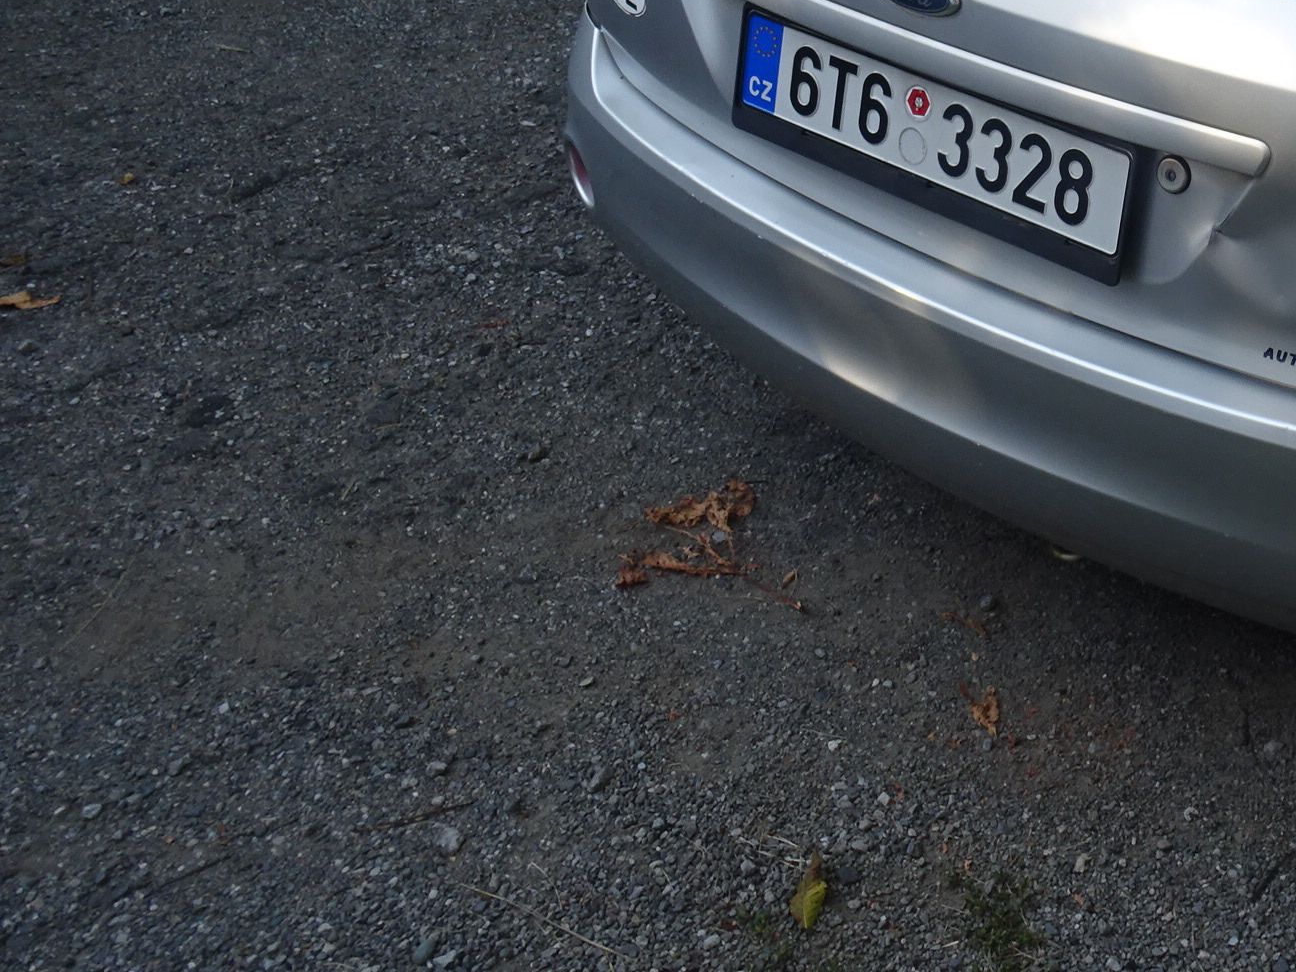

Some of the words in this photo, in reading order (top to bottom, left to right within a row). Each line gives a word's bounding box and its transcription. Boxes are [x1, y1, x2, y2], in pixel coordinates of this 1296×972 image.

[749, 75, 773, 103] CZ
[789, 45, 892, 146] 6T6
[937, 103, 1093, 226] 3328
